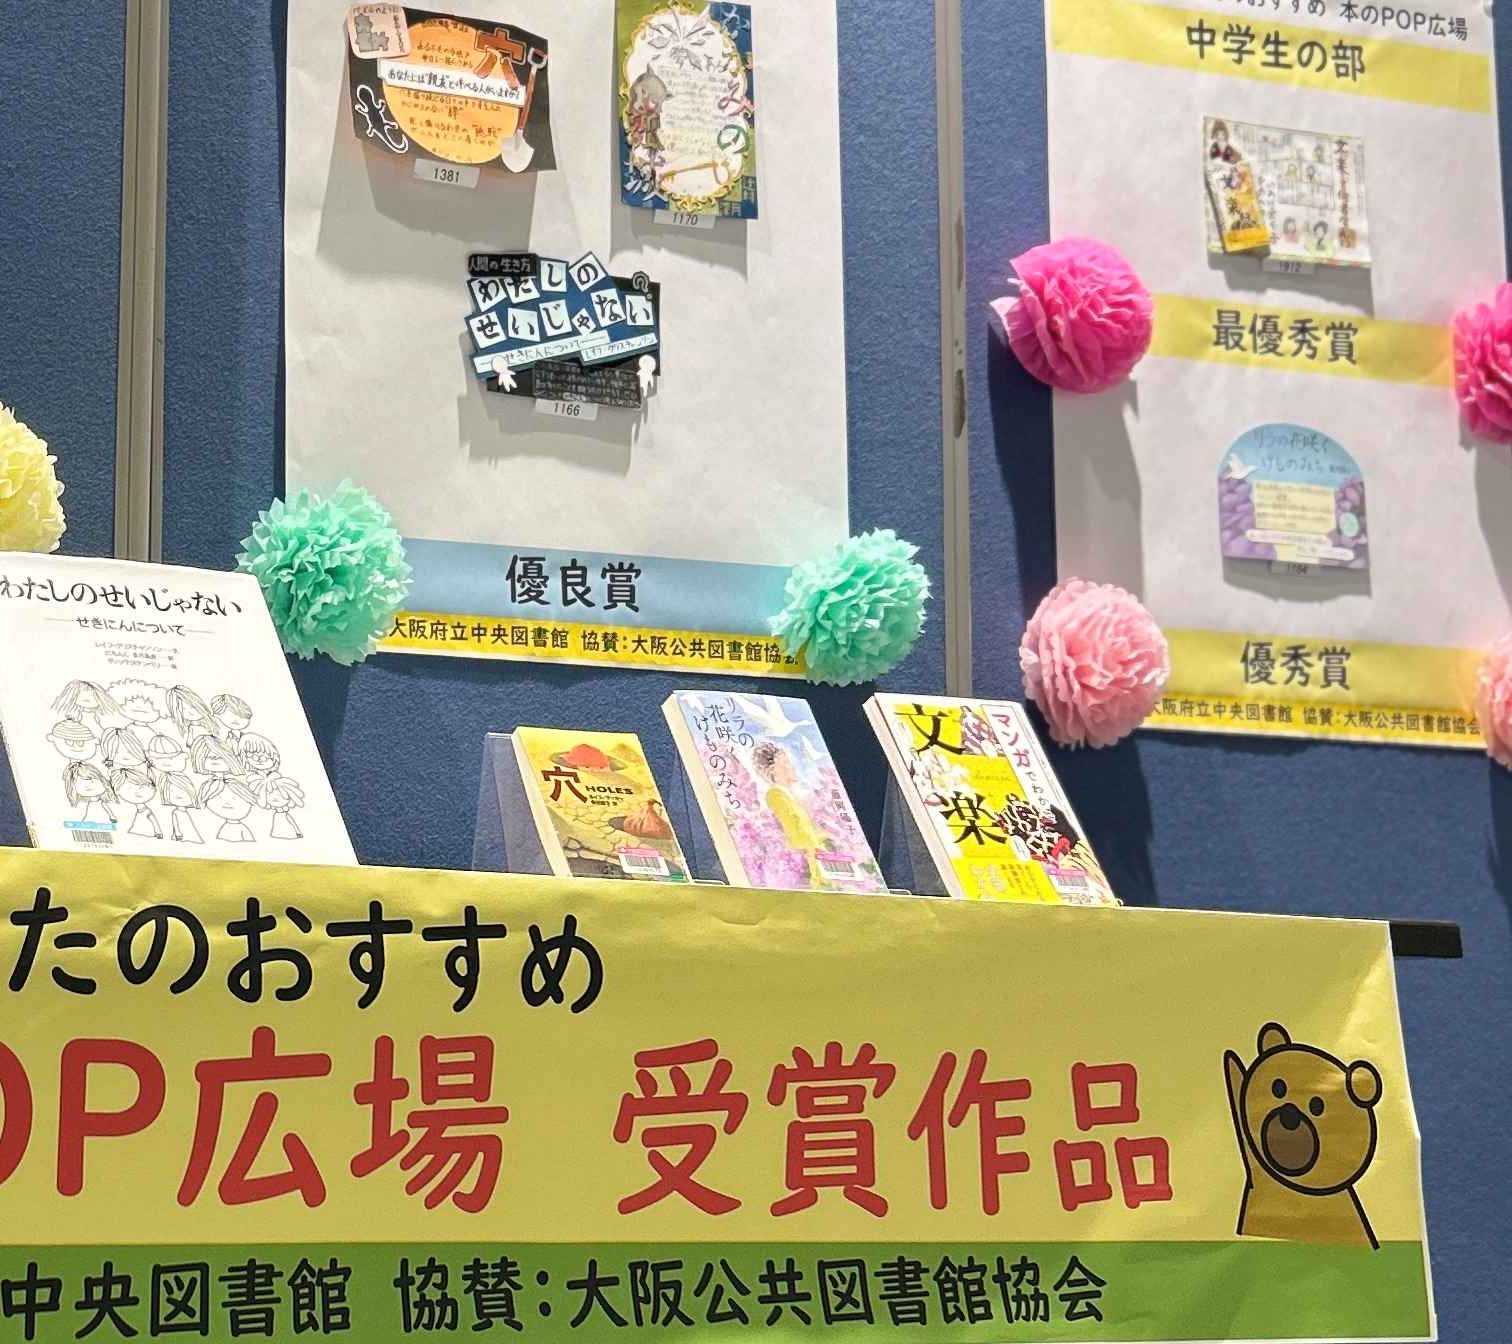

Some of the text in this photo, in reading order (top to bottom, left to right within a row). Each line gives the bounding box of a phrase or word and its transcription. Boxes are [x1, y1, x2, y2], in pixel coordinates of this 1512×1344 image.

[1339, 0, 1468, 42] 本のPOP広場
[1186, 18, 1366, 82] 中学生の部
[433, 167, 460, 183] 1381
[1213, 309, 1358, 365] 最優秀賞
[554, 402, 580, 417] 1166
[0, 575, 242, 617] わたしのせいじゃない
[505, 554, 641, 613] 優良賞
[76, 616, 185, 636] せきにんについて
[1240, 640, 1351, 691] 優秀賞
[541, 766, 588, 804] 穴
[694, 715, 741, 809] けものみち
[585, 785, 634, 795] HOLES
[613, 1038, 1174, 1219] 受賞作品
[396, 1255, 1108, 1333] 協賛：大阪公共図書館協会
